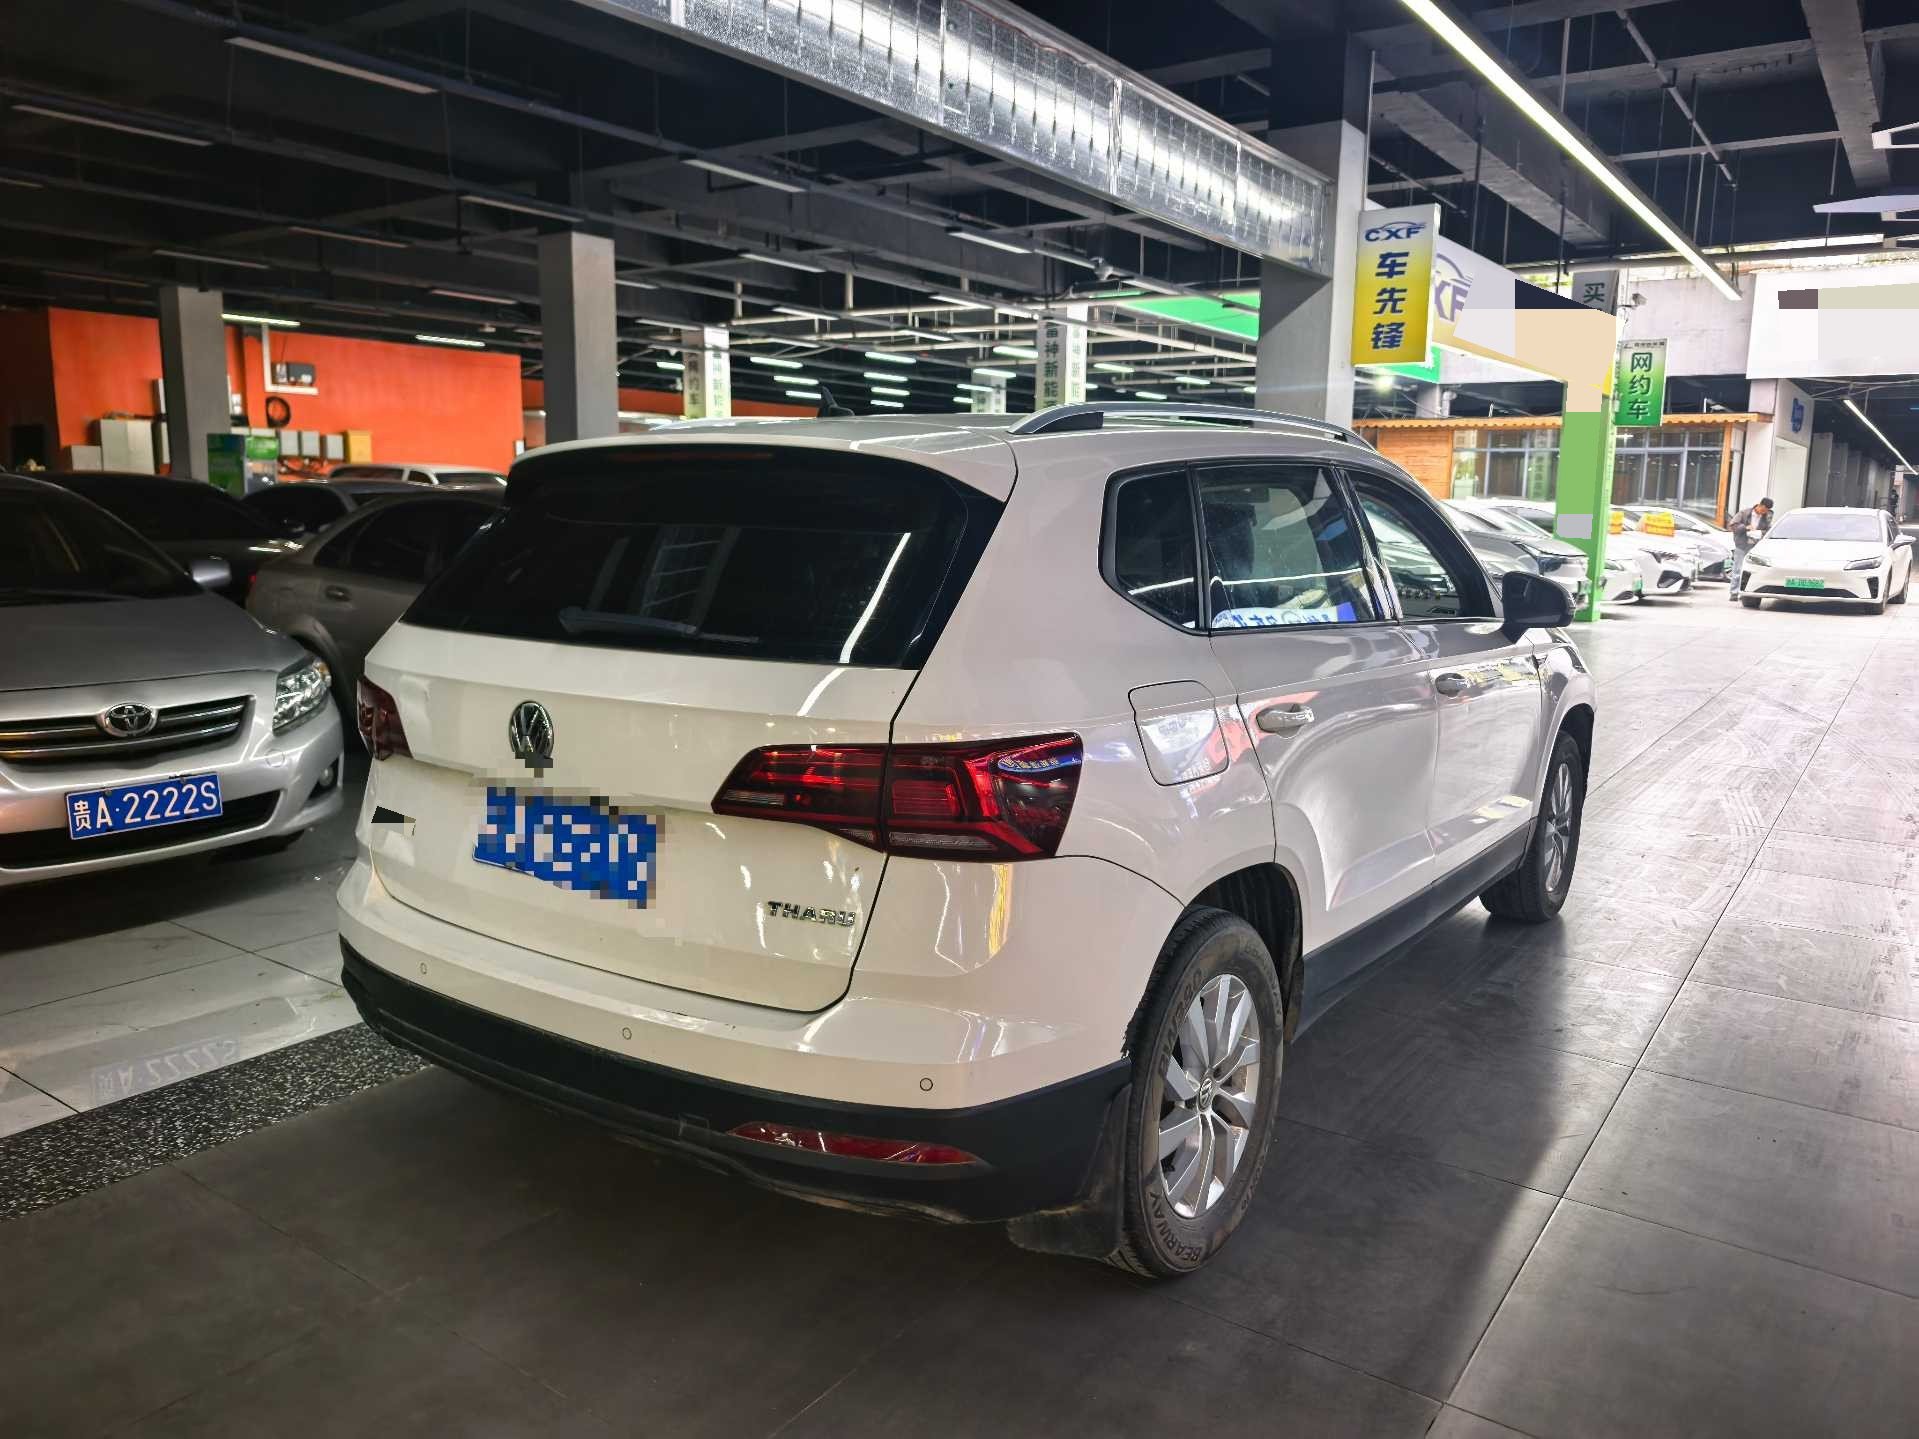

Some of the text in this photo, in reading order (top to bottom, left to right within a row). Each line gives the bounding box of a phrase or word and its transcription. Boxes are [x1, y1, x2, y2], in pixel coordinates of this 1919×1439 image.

[1364, 227, 1423, 242] CXF
[1371, 251, 1410, 349] 车先锋
[1583, 282, 1605, 304] 买
[1626, 352, 1653, 420] 网约车
[768, 901, 857, 927] THARU
[1149, 1191, 1203, 1262] BEARWAY
